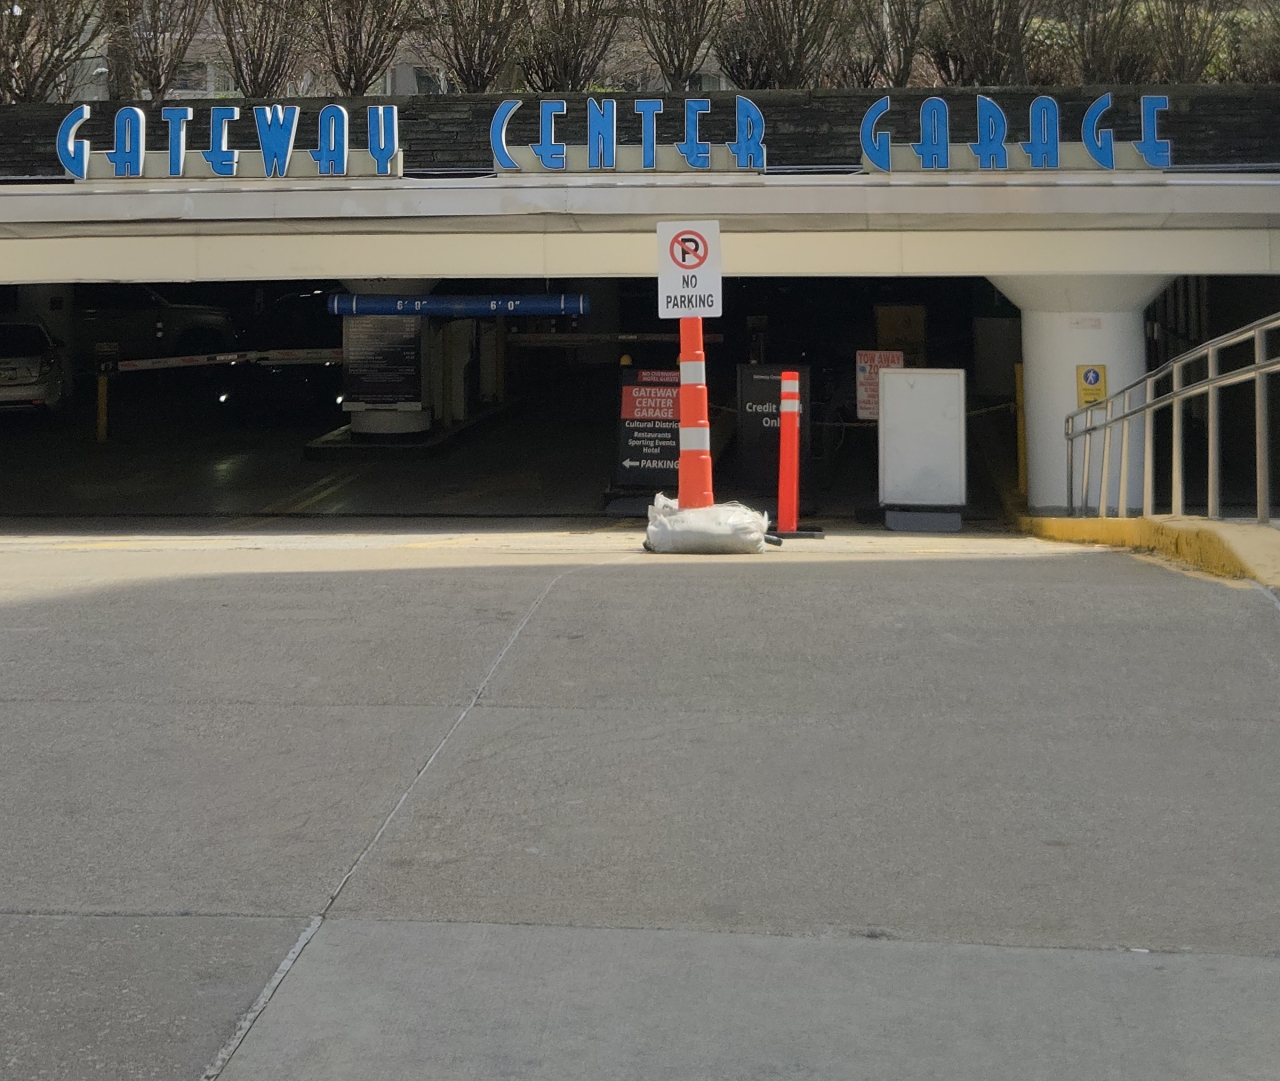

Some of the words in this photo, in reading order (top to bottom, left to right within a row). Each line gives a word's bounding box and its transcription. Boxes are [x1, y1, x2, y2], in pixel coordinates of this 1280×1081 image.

[56, 104, 399, 180] GATEWAY
[490, 95, 765, 170] CENTER
[859, 92, 1171, 172] GARAGE
[682, 274, 698, 289] NO
[666, 293, 714, 309] PARKING
[858, 352, 876, 364] TOW
[878, 352, 901, 364] AWAY
[632, 388, 678, 397] GATEWAY
[635, 398, 673, 408] CENTER
[746, 402, 777, 413] Credit
[634, 408, 673, 418] GARAGE
[625, 420, 654, 428] Cultural
[628, 439, 654, 447] Sporting
[640, 459, 680, 469] PARKING
